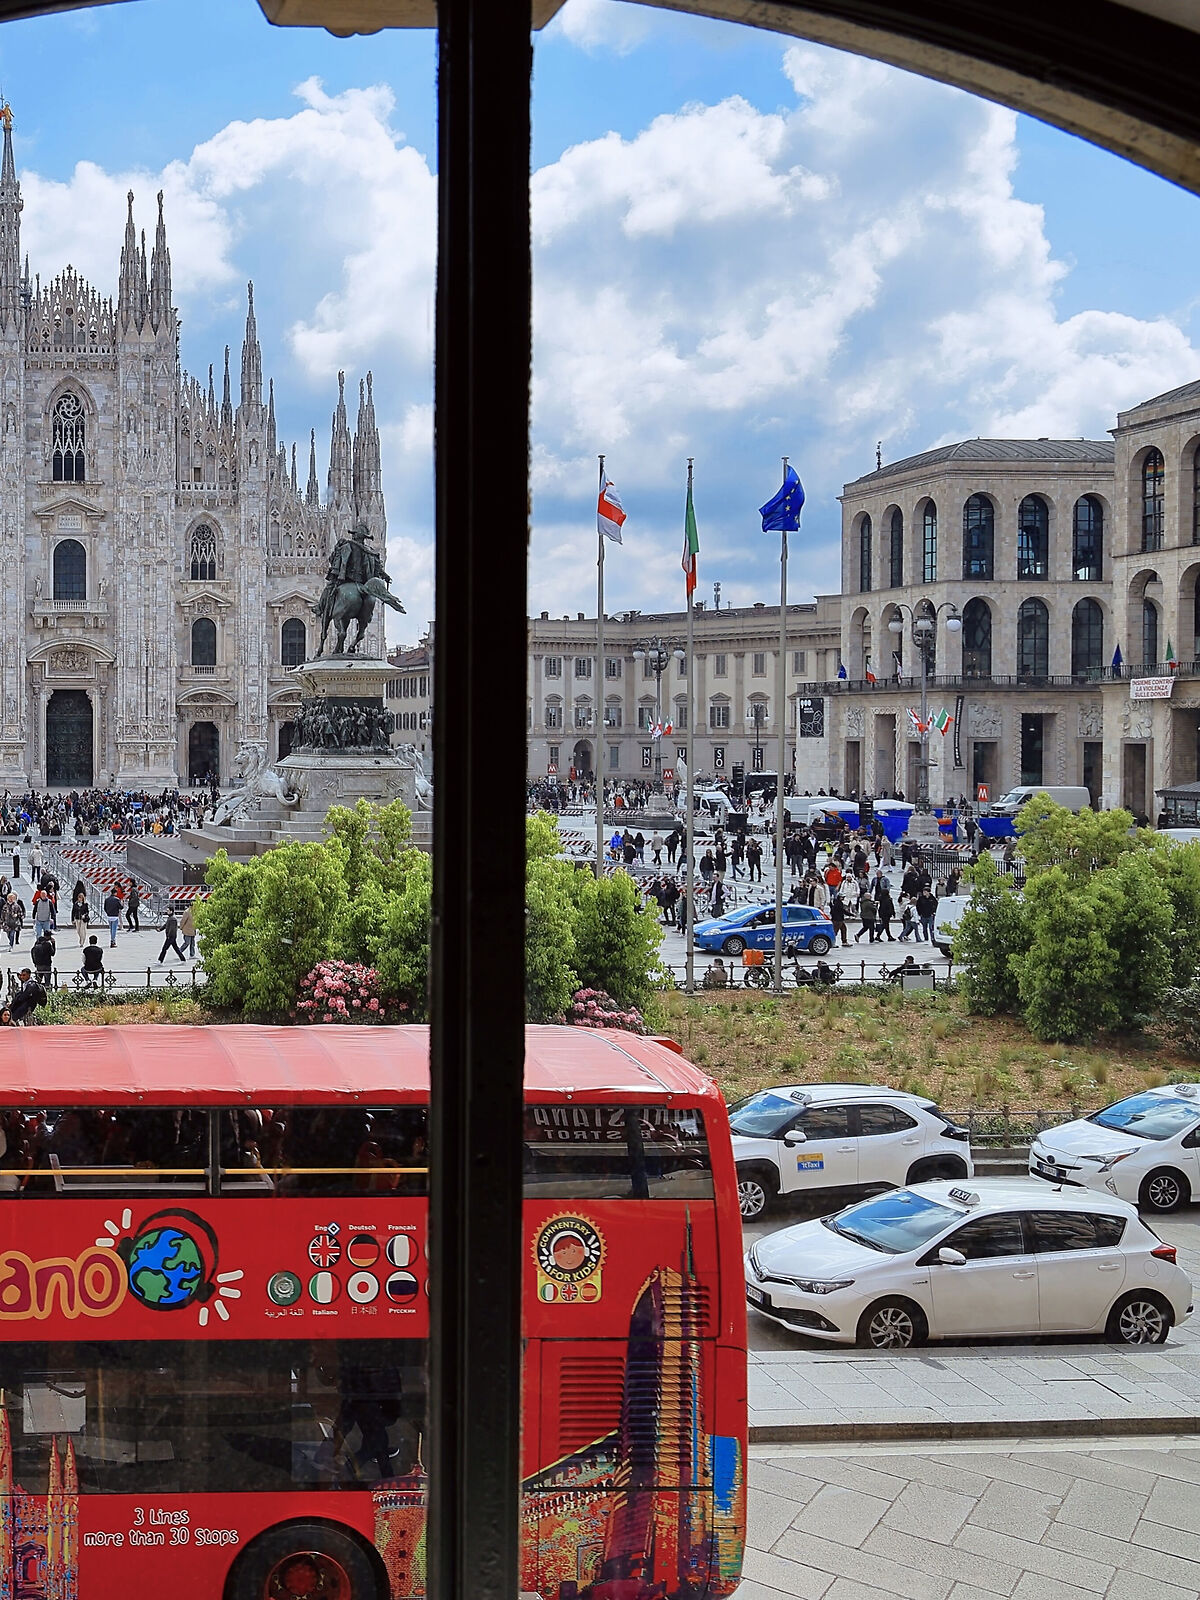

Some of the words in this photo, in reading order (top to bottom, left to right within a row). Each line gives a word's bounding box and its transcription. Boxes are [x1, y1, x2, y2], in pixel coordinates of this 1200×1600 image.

[978, 788, 988, 798] M
[952, 1189, 969, 1199] TAXI
[540, 1221, 591, 1247] COMMENTARY
[549, 1268, 571, 1281] FOR
[572, 1261, 596, 1281] KIDS
[351, 1305, 378, 1315] 日本語
[134, 1507, 144, 1526] 3
[150, 1508, 190, 1525] Lines
[84, 1531, 124, 1546] more
[129, 1529, 164, 1546] than
[169, 1526, 190, 1546] 30
[194, 1528, 239, 1546] Stops
